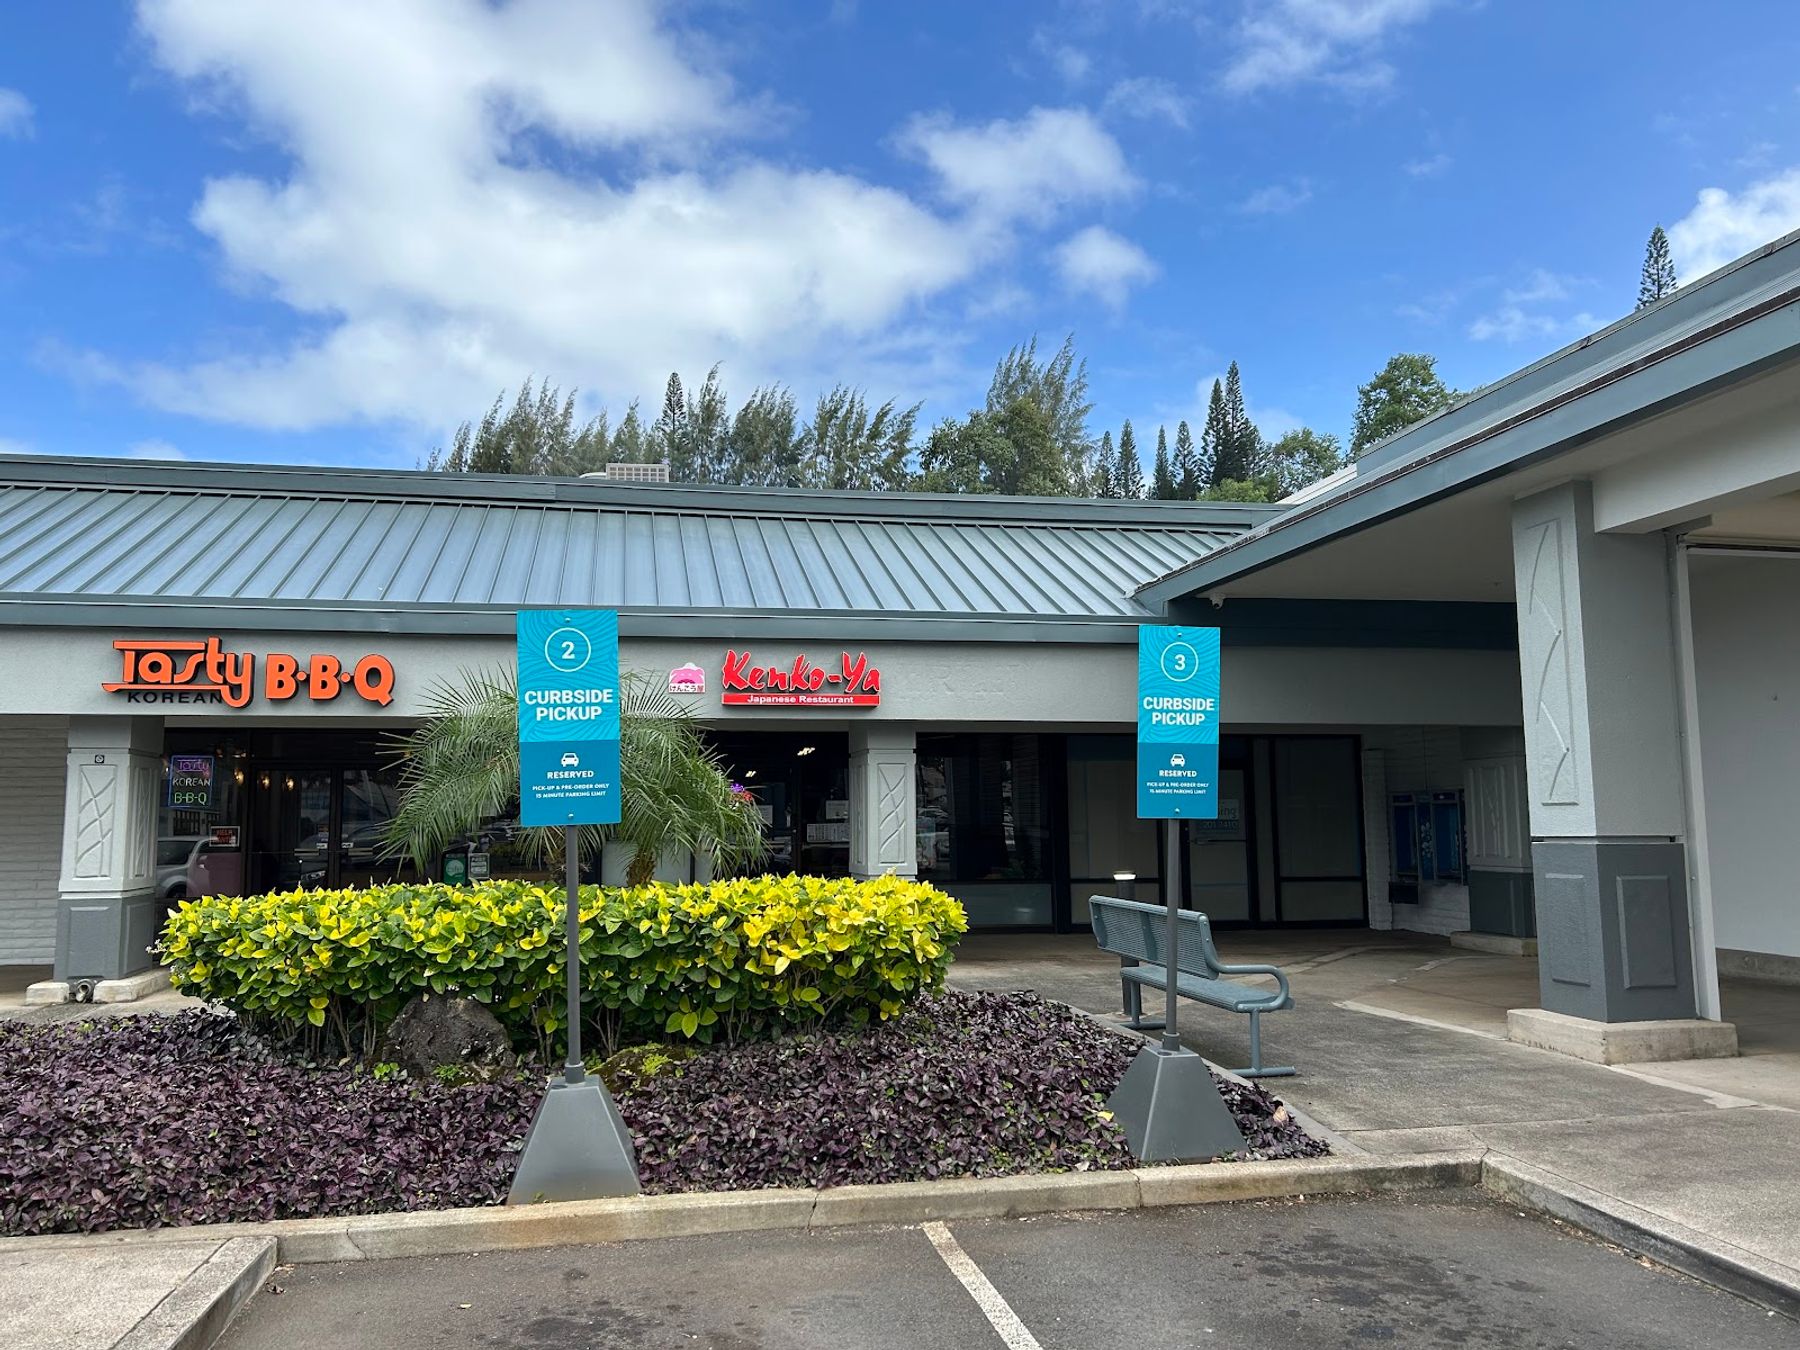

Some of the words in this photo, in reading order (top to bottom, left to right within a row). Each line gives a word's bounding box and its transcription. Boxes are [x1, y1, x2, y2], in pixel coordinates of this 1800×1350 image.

[561, 641, 575, 660] 2
[1174, 654, 1186, 671] 3
[102, 636, 254, 708] Tasty
[722, 649, 881, 693] Kenko-Ya
[127, 691, 222, 704] KOREAN
[524, 689, 613, 705] CURBSIDE
[747, 694, 797, 705] Japanese
[798, 695, 854, 704] Restaurant
[1143, 696, 1215, 711] CURBSIDE
[536, 706, 602, 721] PICKUP
[1151, 712, 1205, 726] PICKUP
[547, 770, 594, 779] RESERVED
[1158, 769, 1197, 778] RESERVED
[172, 777, 211, 787] KOREAN
